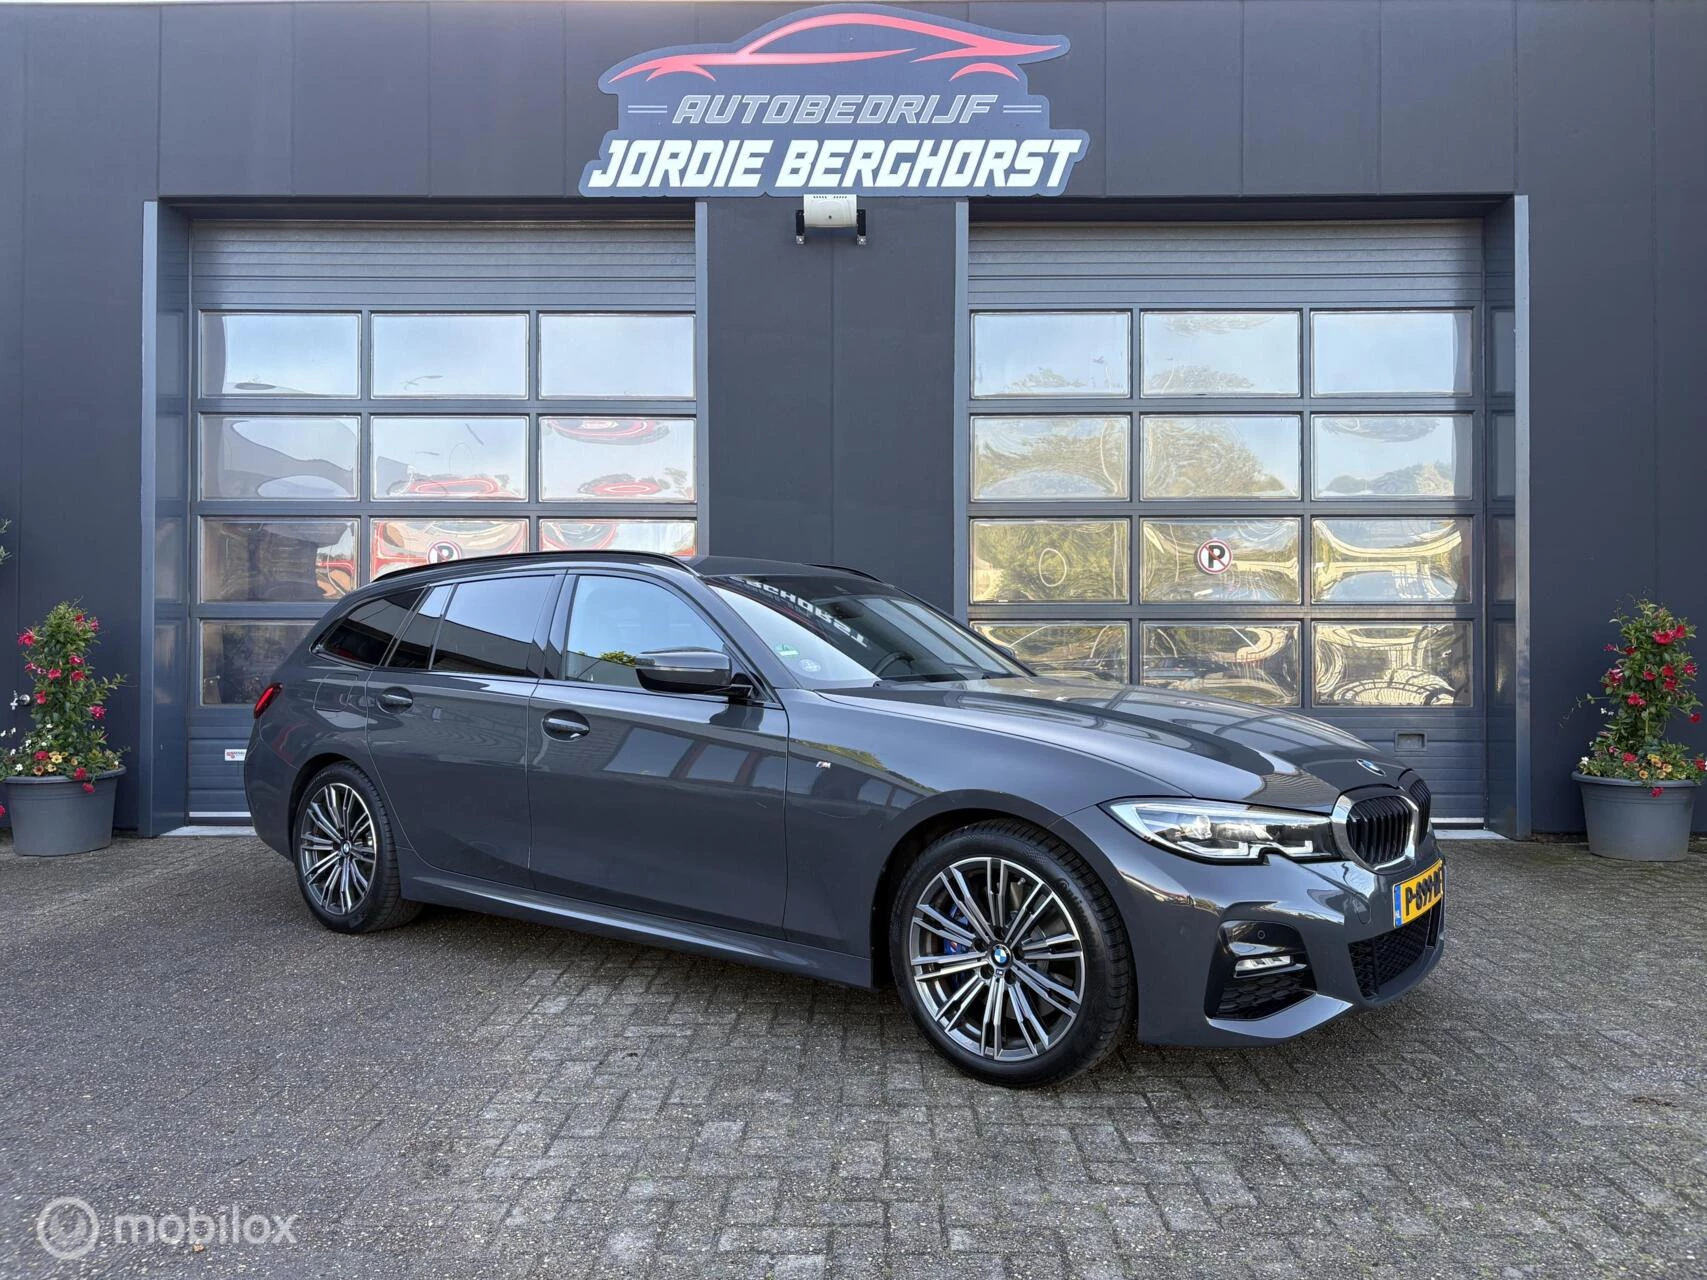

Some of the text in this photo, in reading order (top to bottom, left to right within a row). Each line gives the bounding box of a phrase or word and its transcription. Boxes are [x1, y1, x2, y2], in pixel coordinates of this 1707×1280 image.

[672, 94, 998, 125] AUTOBEDRIJF
[588, 139, 1082, 188] JORDIE BERGHORST
